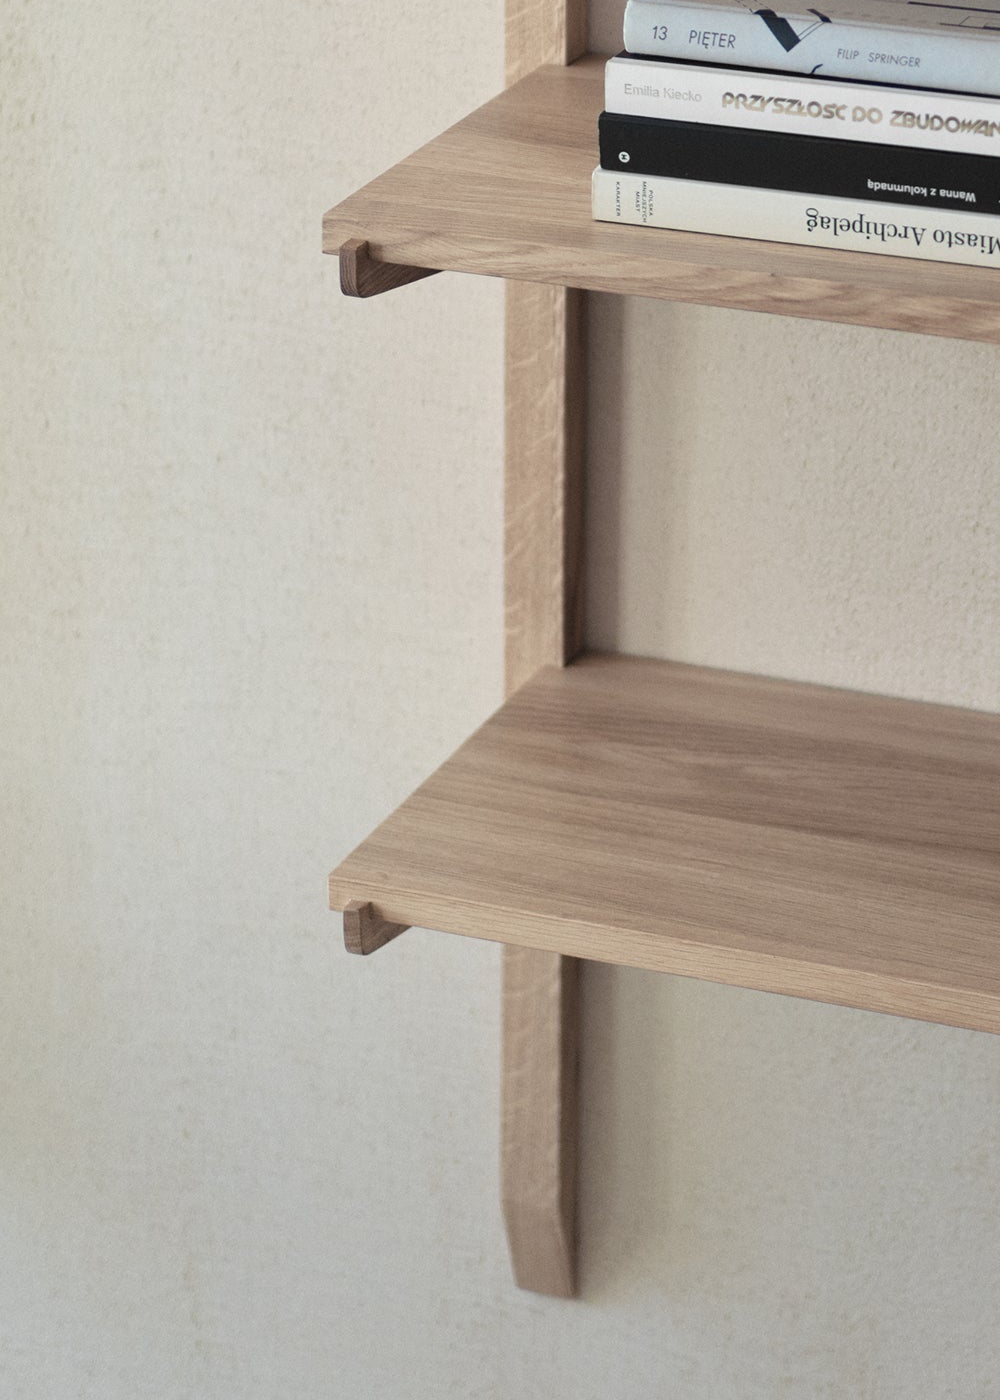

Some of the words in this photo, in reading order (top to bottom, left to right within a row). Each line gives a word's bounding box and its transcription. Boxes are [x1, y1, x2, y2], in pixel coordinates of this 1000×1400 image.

[651, 24, 669, 41] 13
[688, 29, 737, 50] PIĘTER
[836, 47, 860, 61] FILIP
[867, 51, 922, 68] SPRINGER
[623, 82, 660, 99] Emilia
[662, 86, 703, 103] Kiecko
[851, 105, 884, 125] DO
[866, 178, 928, 198] kolumnadą
[929, 187, 937, 196] z
[939, 190, 977, 203] Wanna
[804, 206, 927, 247] Archipelag
